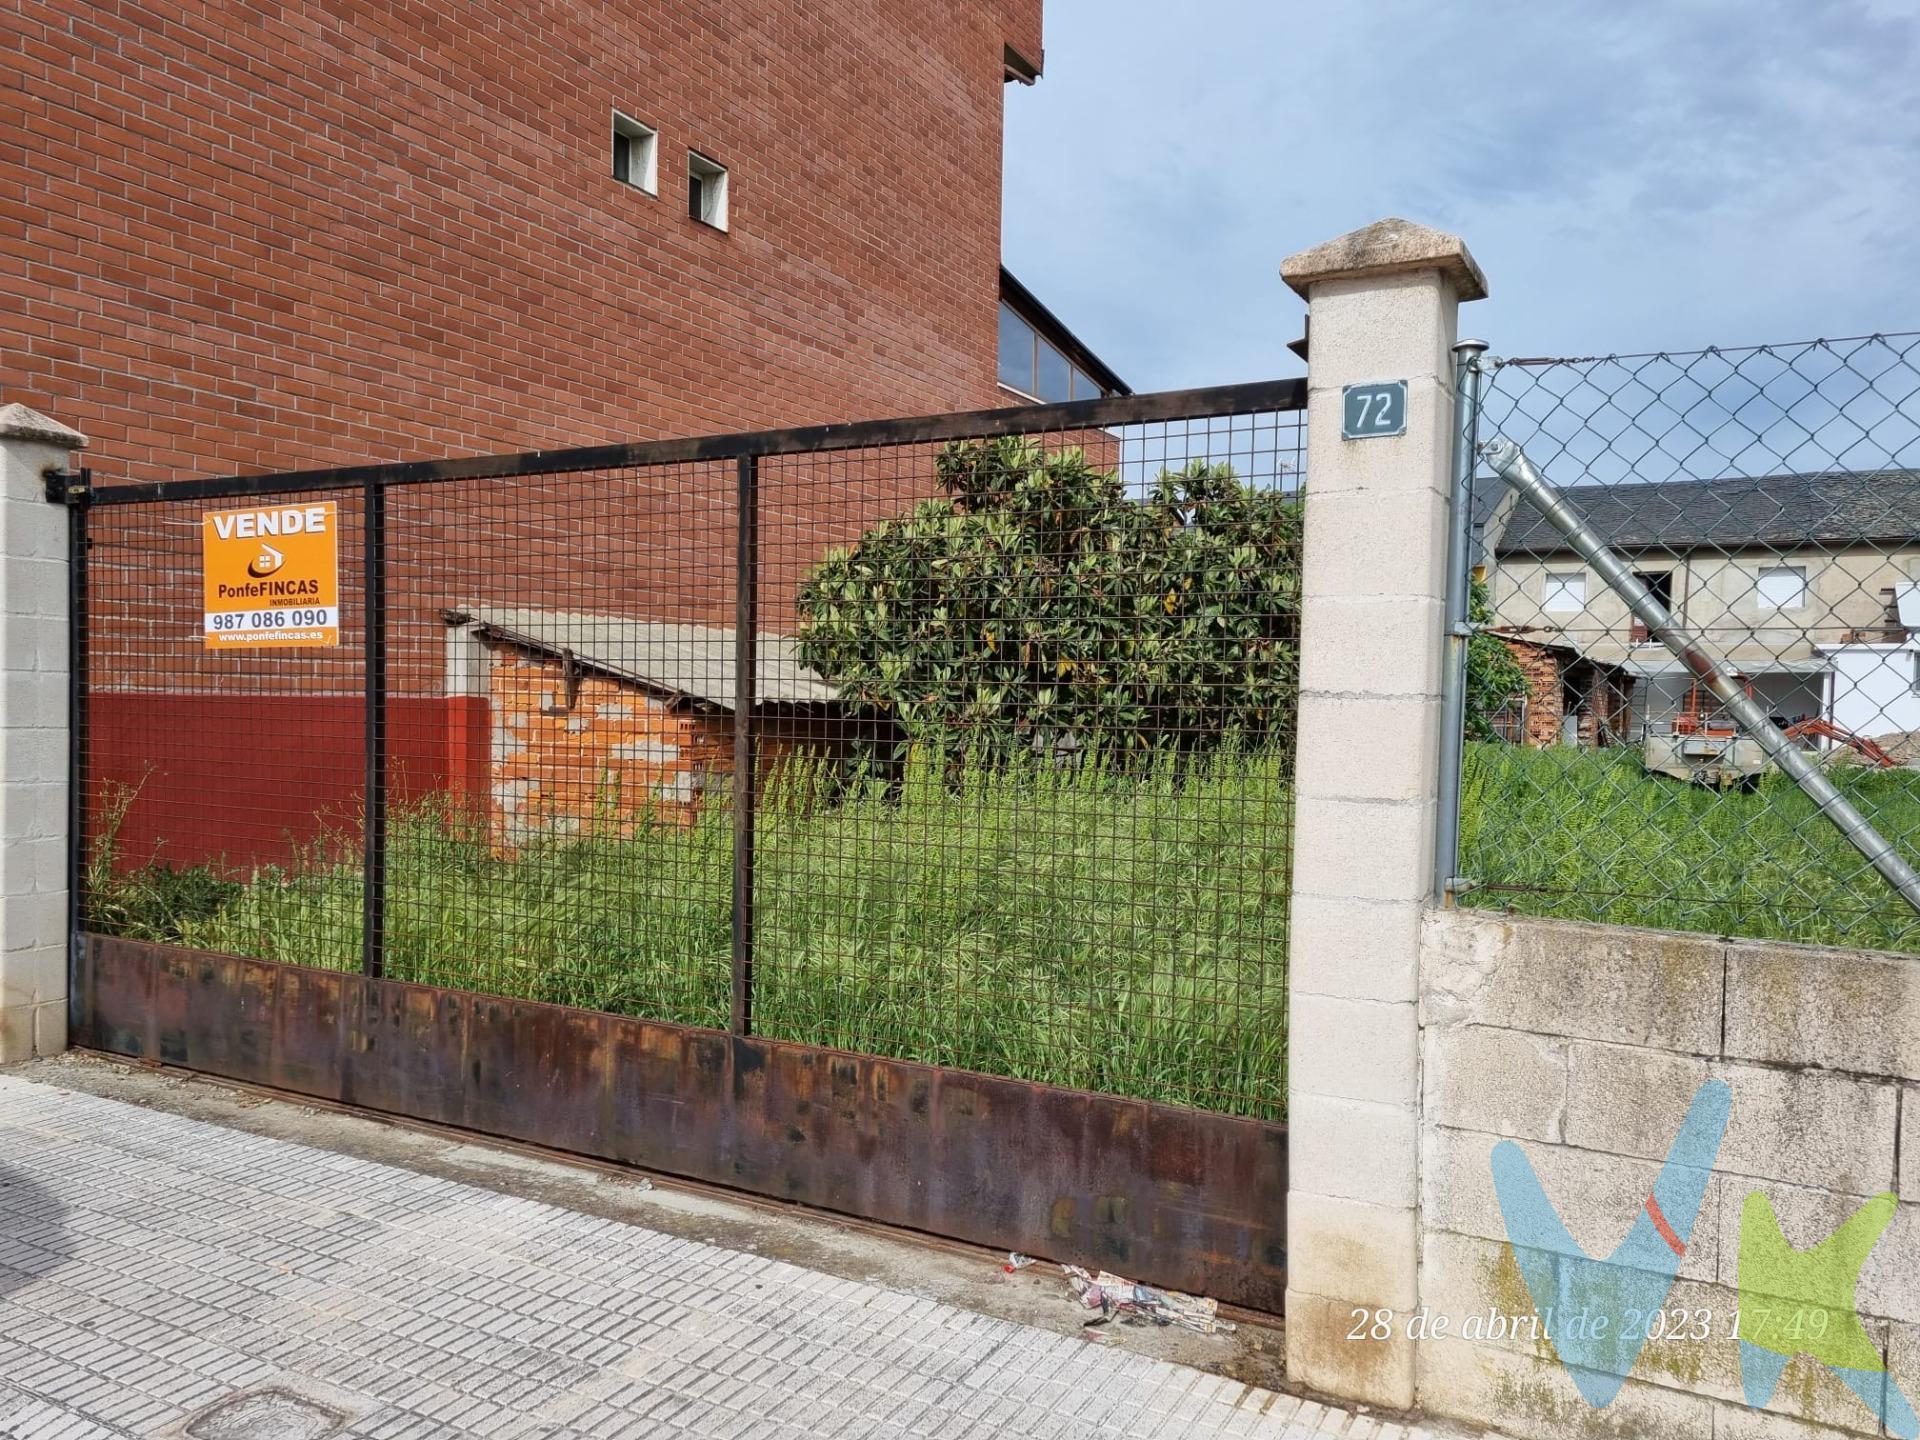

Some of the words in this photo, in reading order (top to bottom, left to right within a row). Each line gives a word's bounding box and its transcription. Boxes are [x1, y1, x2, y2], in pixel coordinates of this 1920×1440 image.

[1356, 392, 1393, 429] 72
[213, 507, 326, 540] VENDE
[218, 579, 319, 598] PonfeFINCAS
[269, 598, 321, 607] INMOBILIARIA
[213, 614, 245, 630] 987
[251, 611, 285, 628] 086
[291, 609, 328, 626] 090
[218, 630, 324, 642] www.ponfefincas.es
